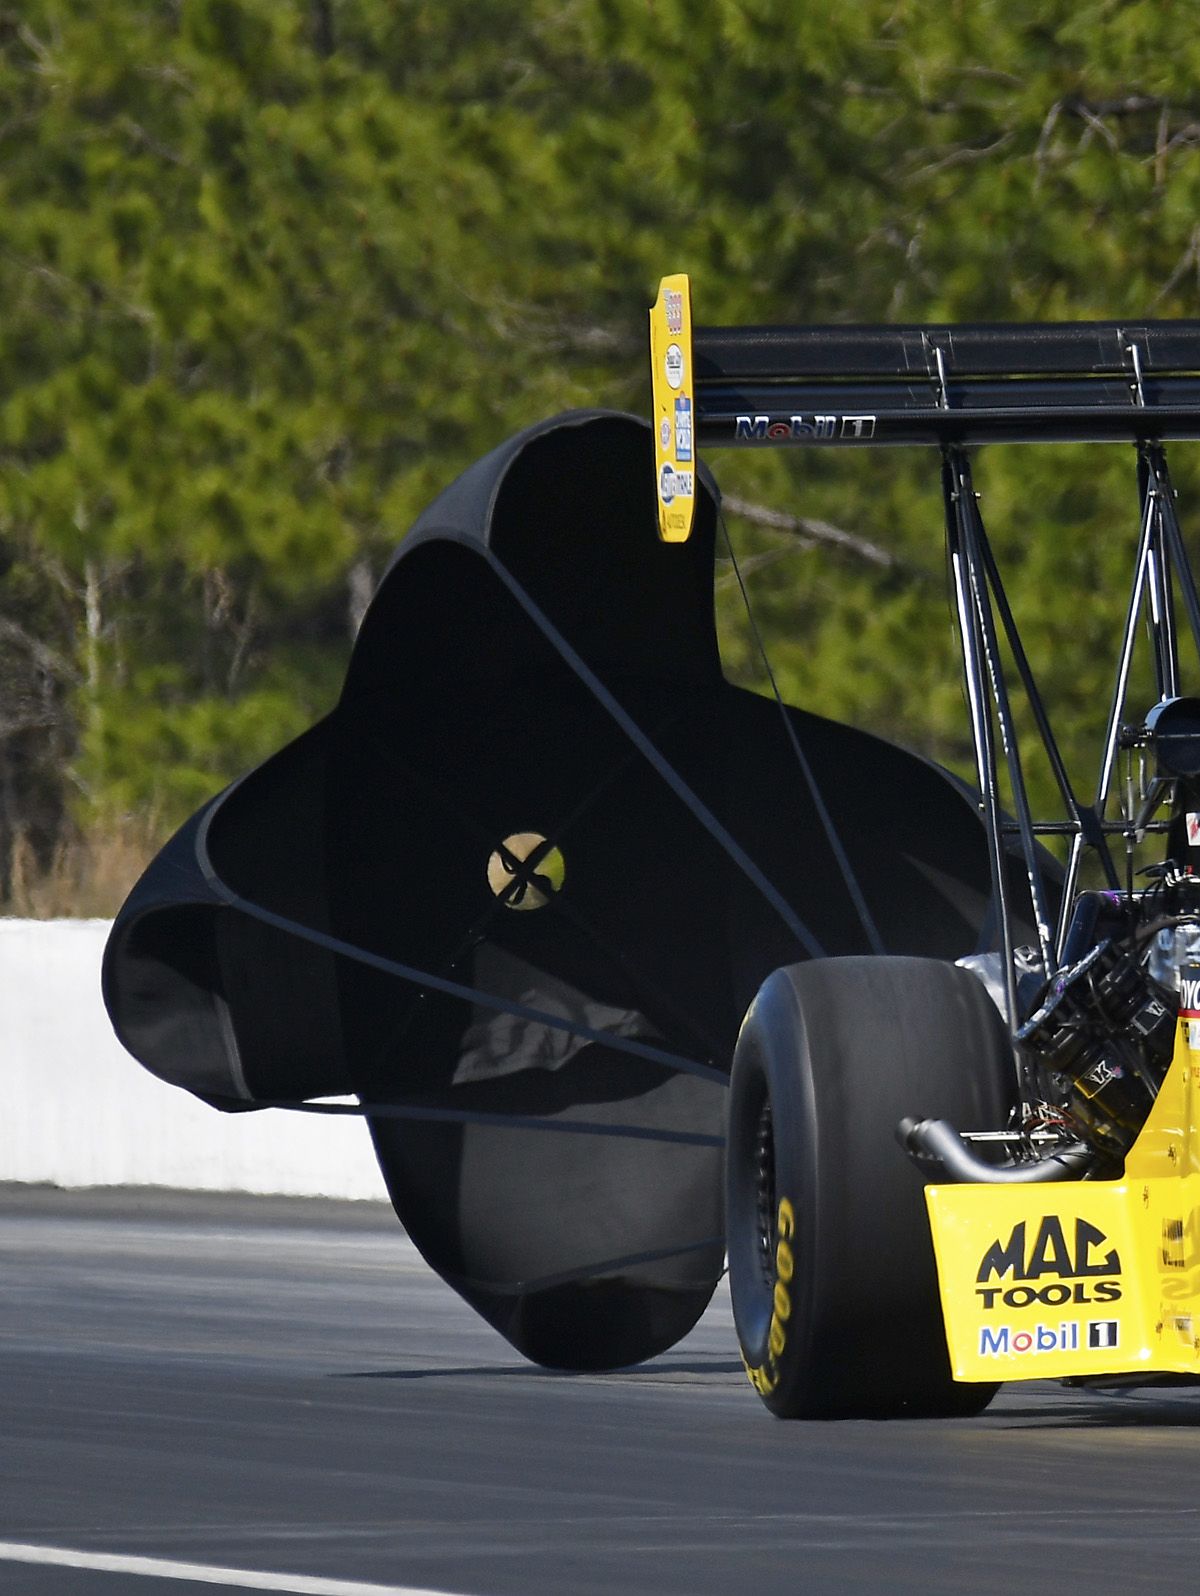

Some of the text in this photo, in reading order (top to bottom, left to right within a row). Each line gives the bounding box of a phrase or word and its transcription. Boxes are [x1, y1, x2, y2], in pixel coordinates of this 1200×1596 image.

[736, 415, 836, 439] Mobil
[976, 1215, 1122, 1283] MAC
[975, 1281, 1122, 1309] TOOLS
[980, 1322, 1114, 1355] Mobil 1
